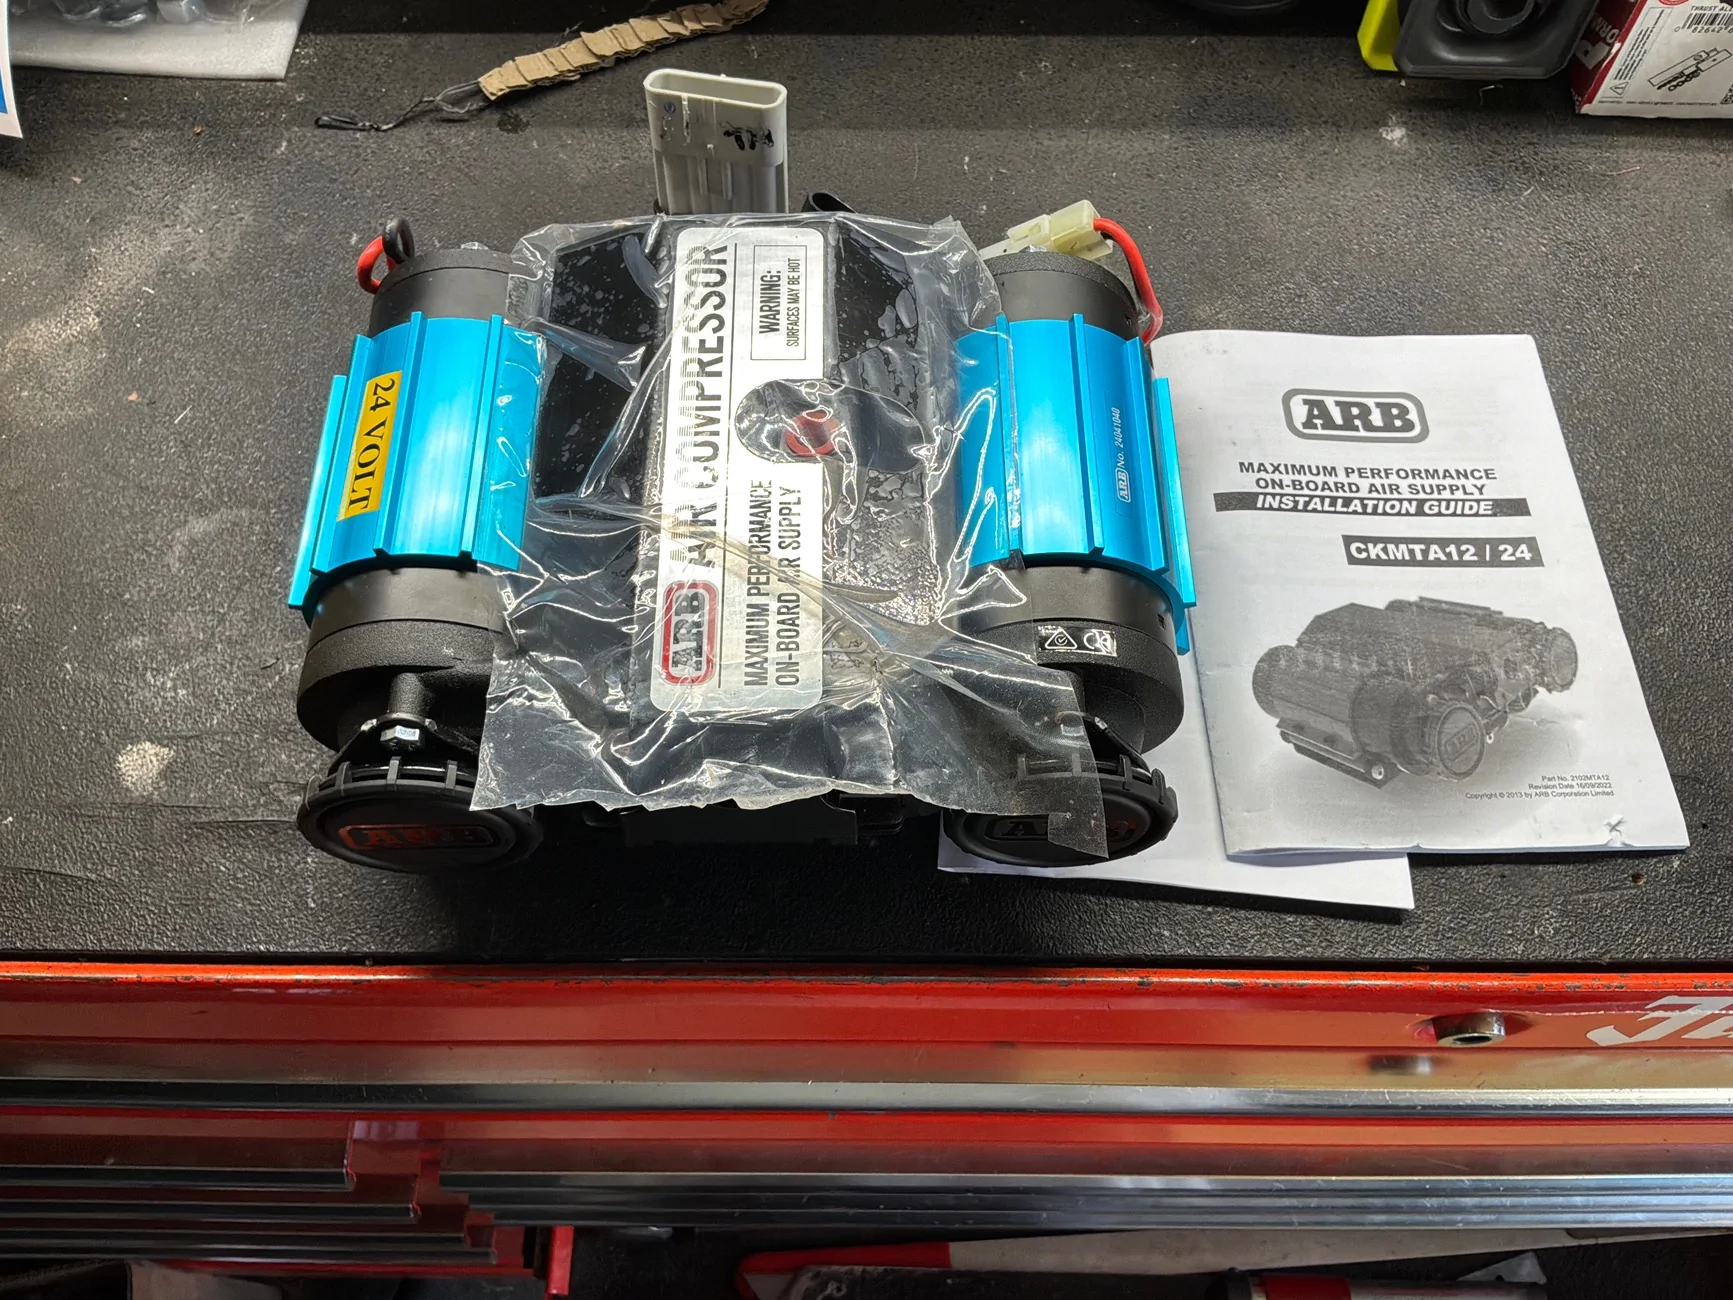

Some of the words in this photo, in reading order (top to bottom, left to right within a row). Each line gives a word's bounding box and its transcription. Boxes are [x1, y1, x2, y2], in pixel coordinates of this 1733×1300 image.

[787, 258, 801, 273] HOT
[787, 274, 800, 286] BE
[758, 270, 782, 334] WARNING:
[786, 287, 800, 305] MAY
[786, 307, 799, 347] SURFACES
[675, 245, 728, 488] COMPRESSOR
[369, 378, 396, 412] 24
[1111, 407, 1124, 448] 24041040
[1300, 399, 1415, 433] ARB
[347, 417, 388, 510] VOLT
[1117, 451, 1125, 468] No.
[1239, 461, 1338, 478] MAXIMUM
[1344, 466, 1497, 480] PERFORMANCE
[1118, 471, 1129, 500] ARB
[1255, 477, 1360, 494] ON-BOARD
[1367, 483, 1403, 496] AIR
[1407, 483, 1486, 496] SUPPLY
[777, 486, 802, 550] SUPPLY
[1256, 494, 1418, 514] INSTALLATION
[1423, 500, 1493, 515] GUIDE
[669, 503, 717, 569] AIR
[747, 479, 772, 596] PERFORMANCE
[671, 592, 706, 672] ARB
[744, 604, 770, 687] MAXIMUM
[775, 593, 801, 686] ON-BOARD
[1465, 791, 1498, 800] Copyright
[1524, 791, 1533, 799] by
[1534, 790, 1550, 798] ARB
[1551, 790, 1590, 799] Corporation
[1590, 789, 1615, 797] Limited
